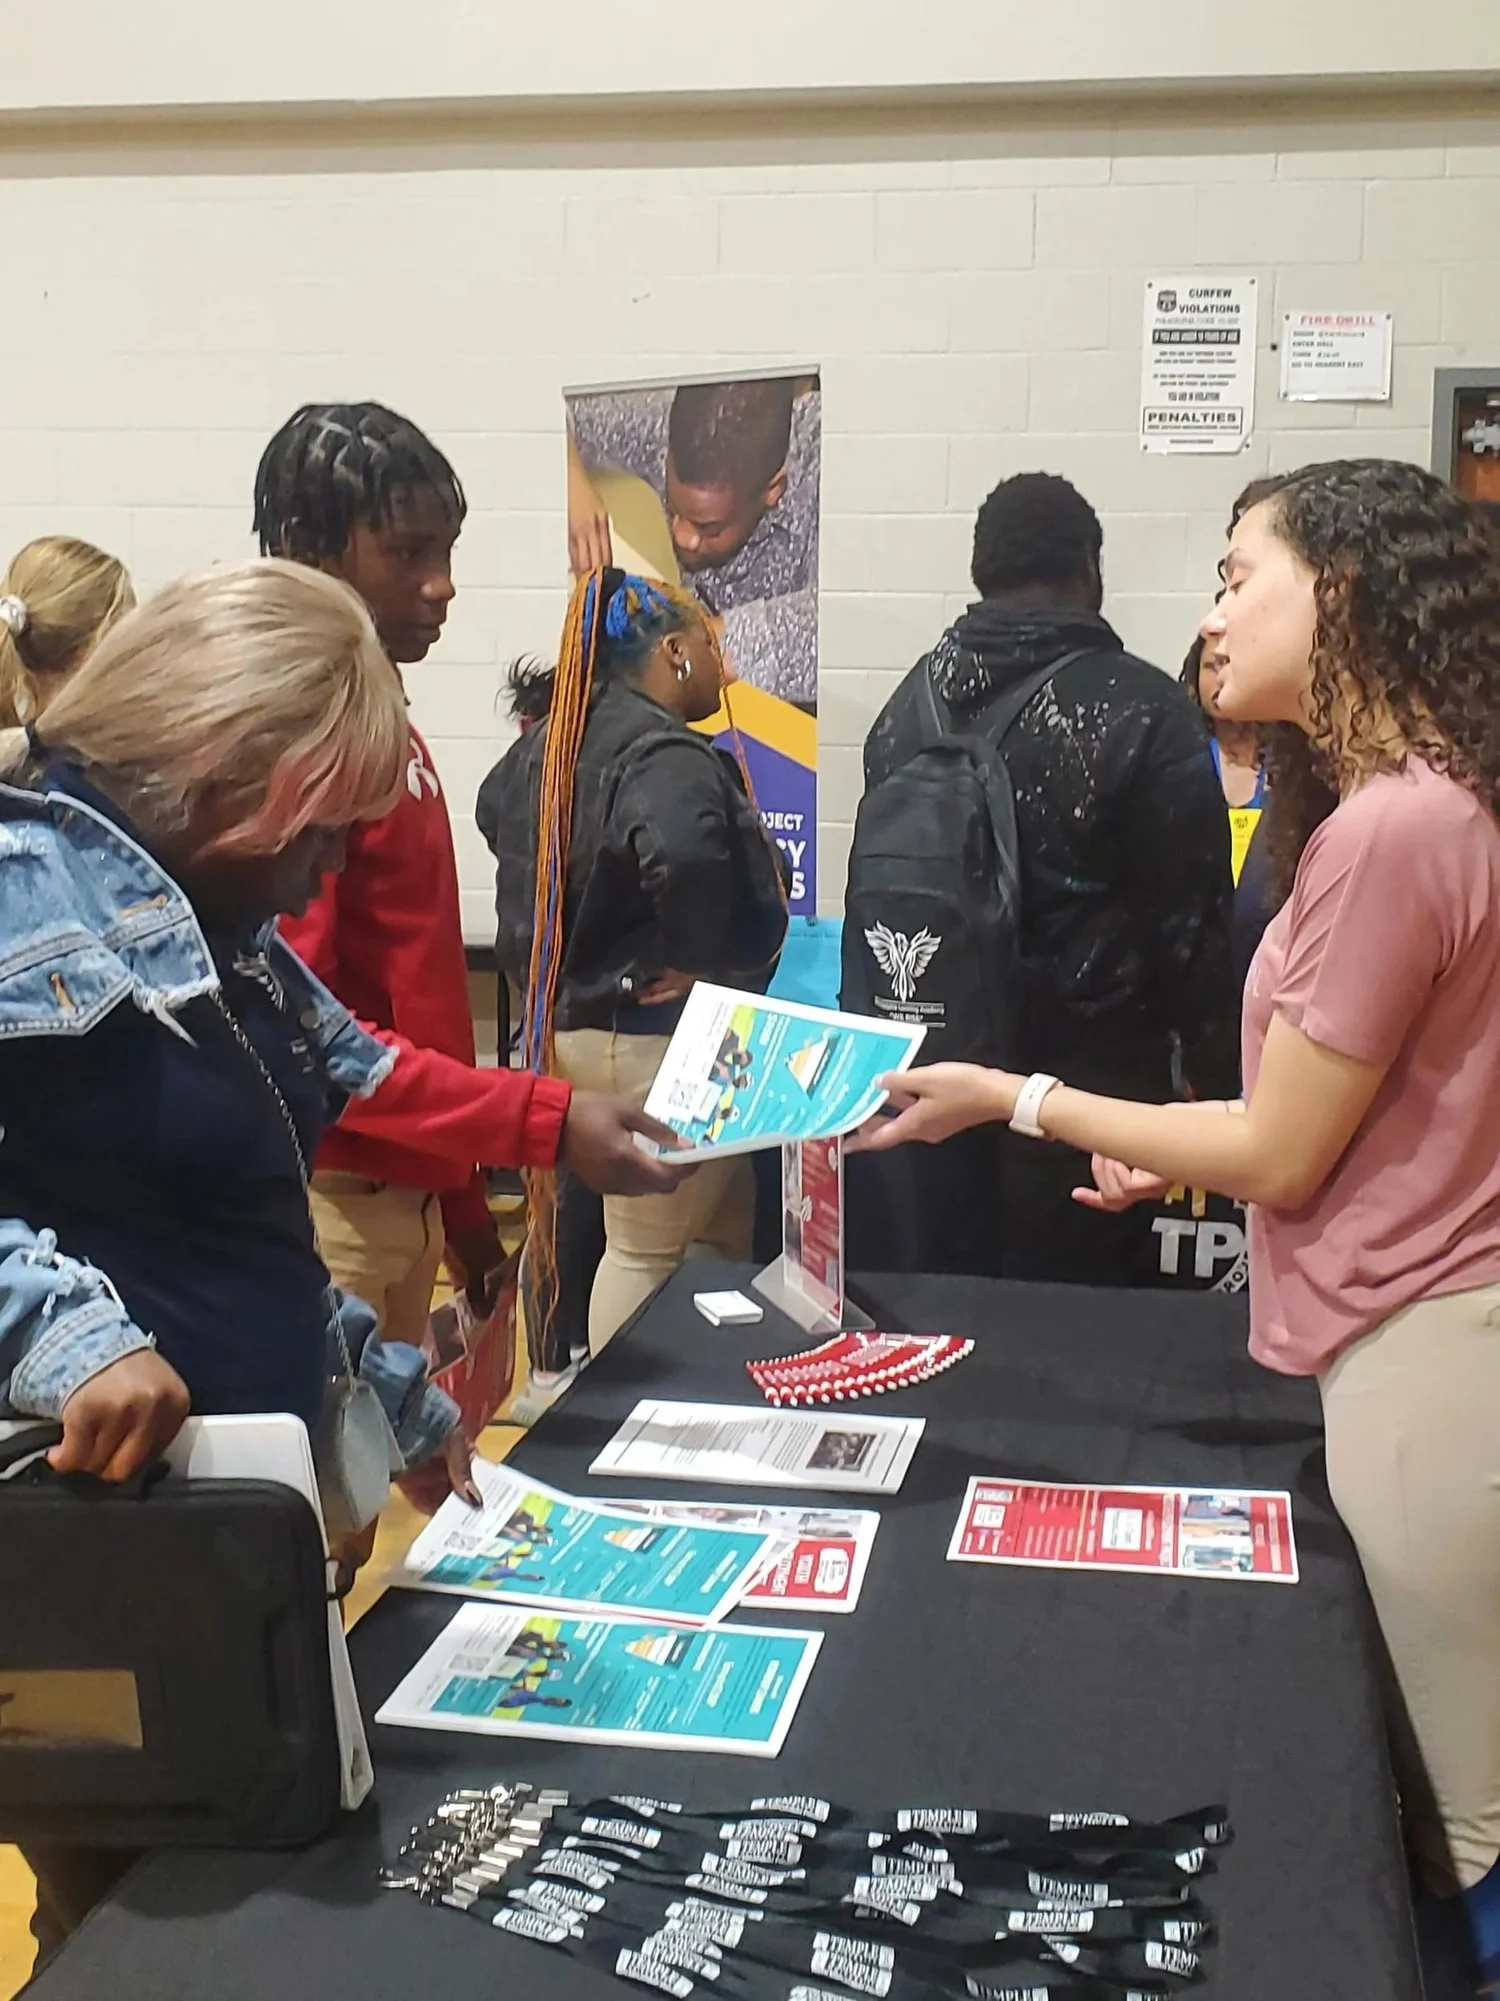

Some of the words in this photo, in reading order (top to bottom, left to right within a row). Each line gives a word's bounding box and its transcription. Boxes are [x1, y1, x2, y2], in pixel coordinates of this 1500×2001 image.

[1188, 288, 1232, 299] CURFEW
[1179, 303, 1241, 314] VIOLATIONS
[1148, 412, 1237, 423] PENALTIES
[911, 1809, 962, 1828] TEMPLE
[887, 1857, 940, 1877] TEMPLE
[1041, 1876, 1093, 1901] TEMPLE
[1025, 1911, 1079, 1929] TEMPLE
[829, 1935, 880, 1962] TEMPLE
